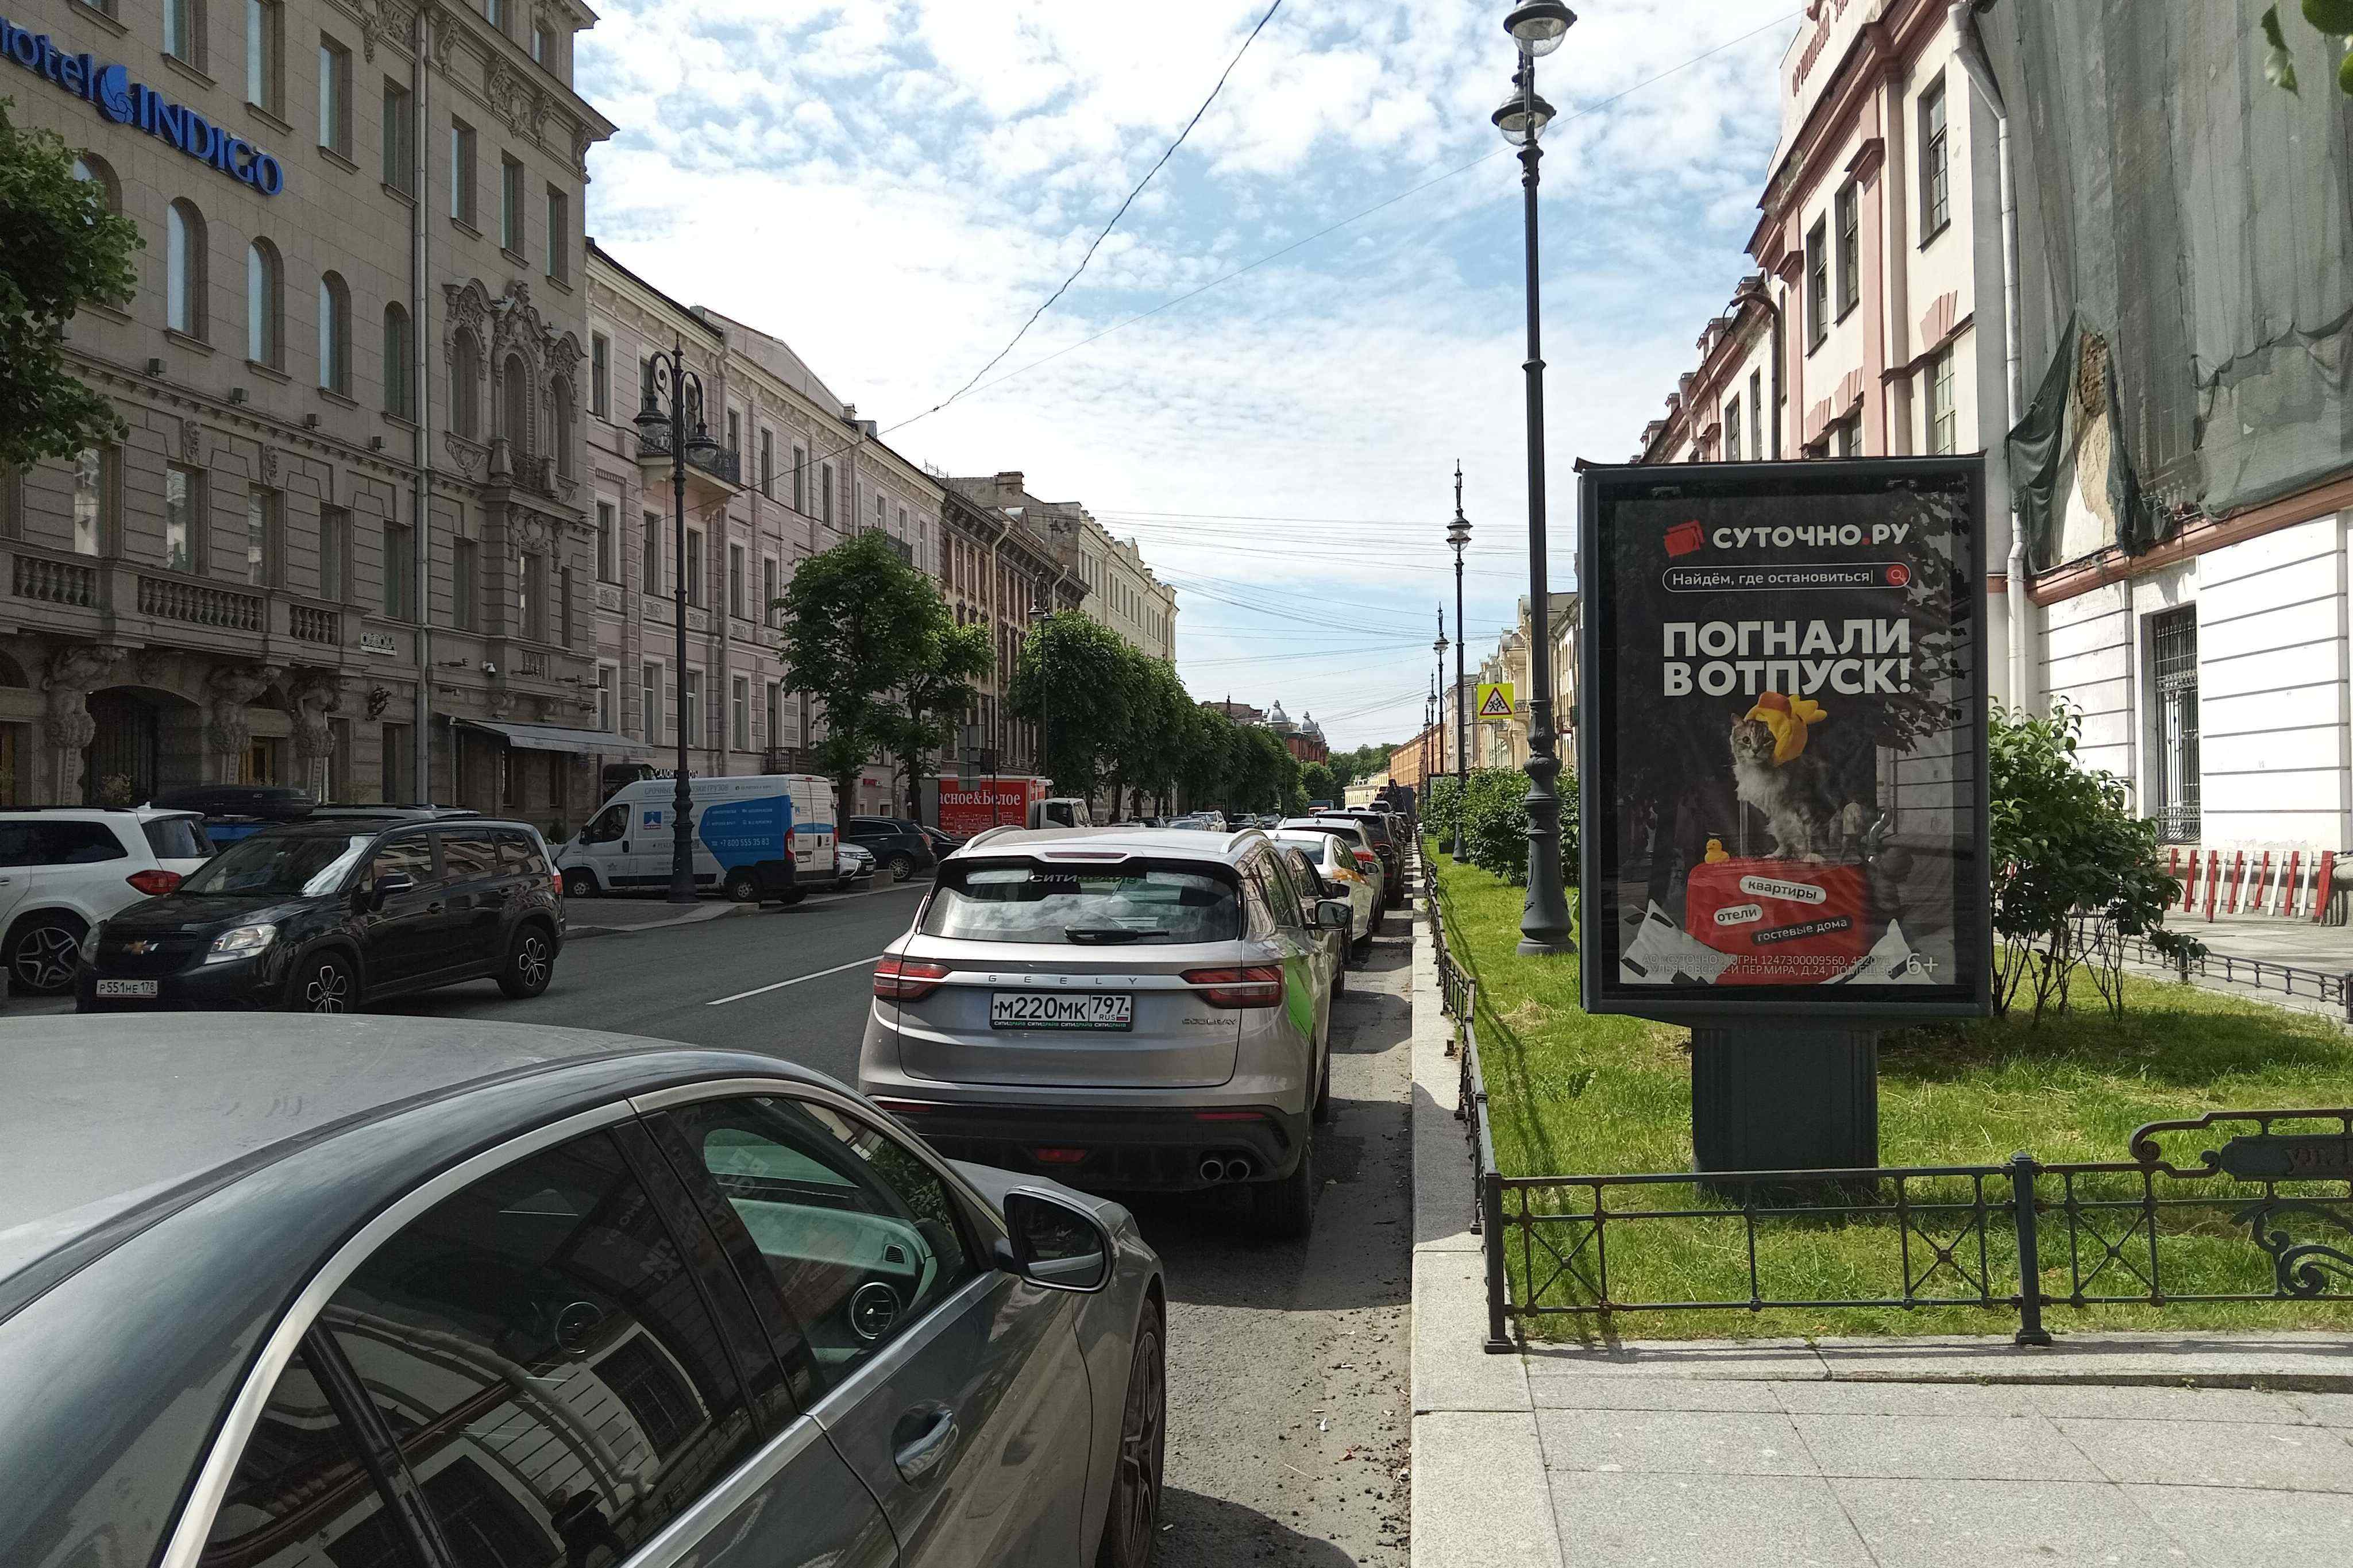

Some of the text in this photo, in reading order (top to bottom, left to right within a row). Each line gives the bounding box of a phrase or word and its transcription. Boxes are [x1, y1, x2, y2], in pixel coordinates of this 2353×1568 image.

[137, 83, 283, 195] INDIGO
[1712, 523, 1910, 549] СУТОЧНО.РУ
[1673, 571, 1870, 586] Найдём, где остановиться
[1663, 619, 1911, 657] ПОГНАЛИ
[1664, 658, 1911, 697] В ОТПУСК!
[655, 768, 674, 779] САЛОН
[1748, 880, 1817, 899] квартиры
[1717, 909, 1757, 922] отели
[1757, 919, 1847, 941] гостевые дома
[1730, 955, 1757, 965] ОГРН
[1761, 956, 1847, 965] 1247300009560,
[1906, 953, 1939, 975] 6+
[989, 975, 1137, 985] GEELY
[998, 997, 1126, 1019] М220МК 797
